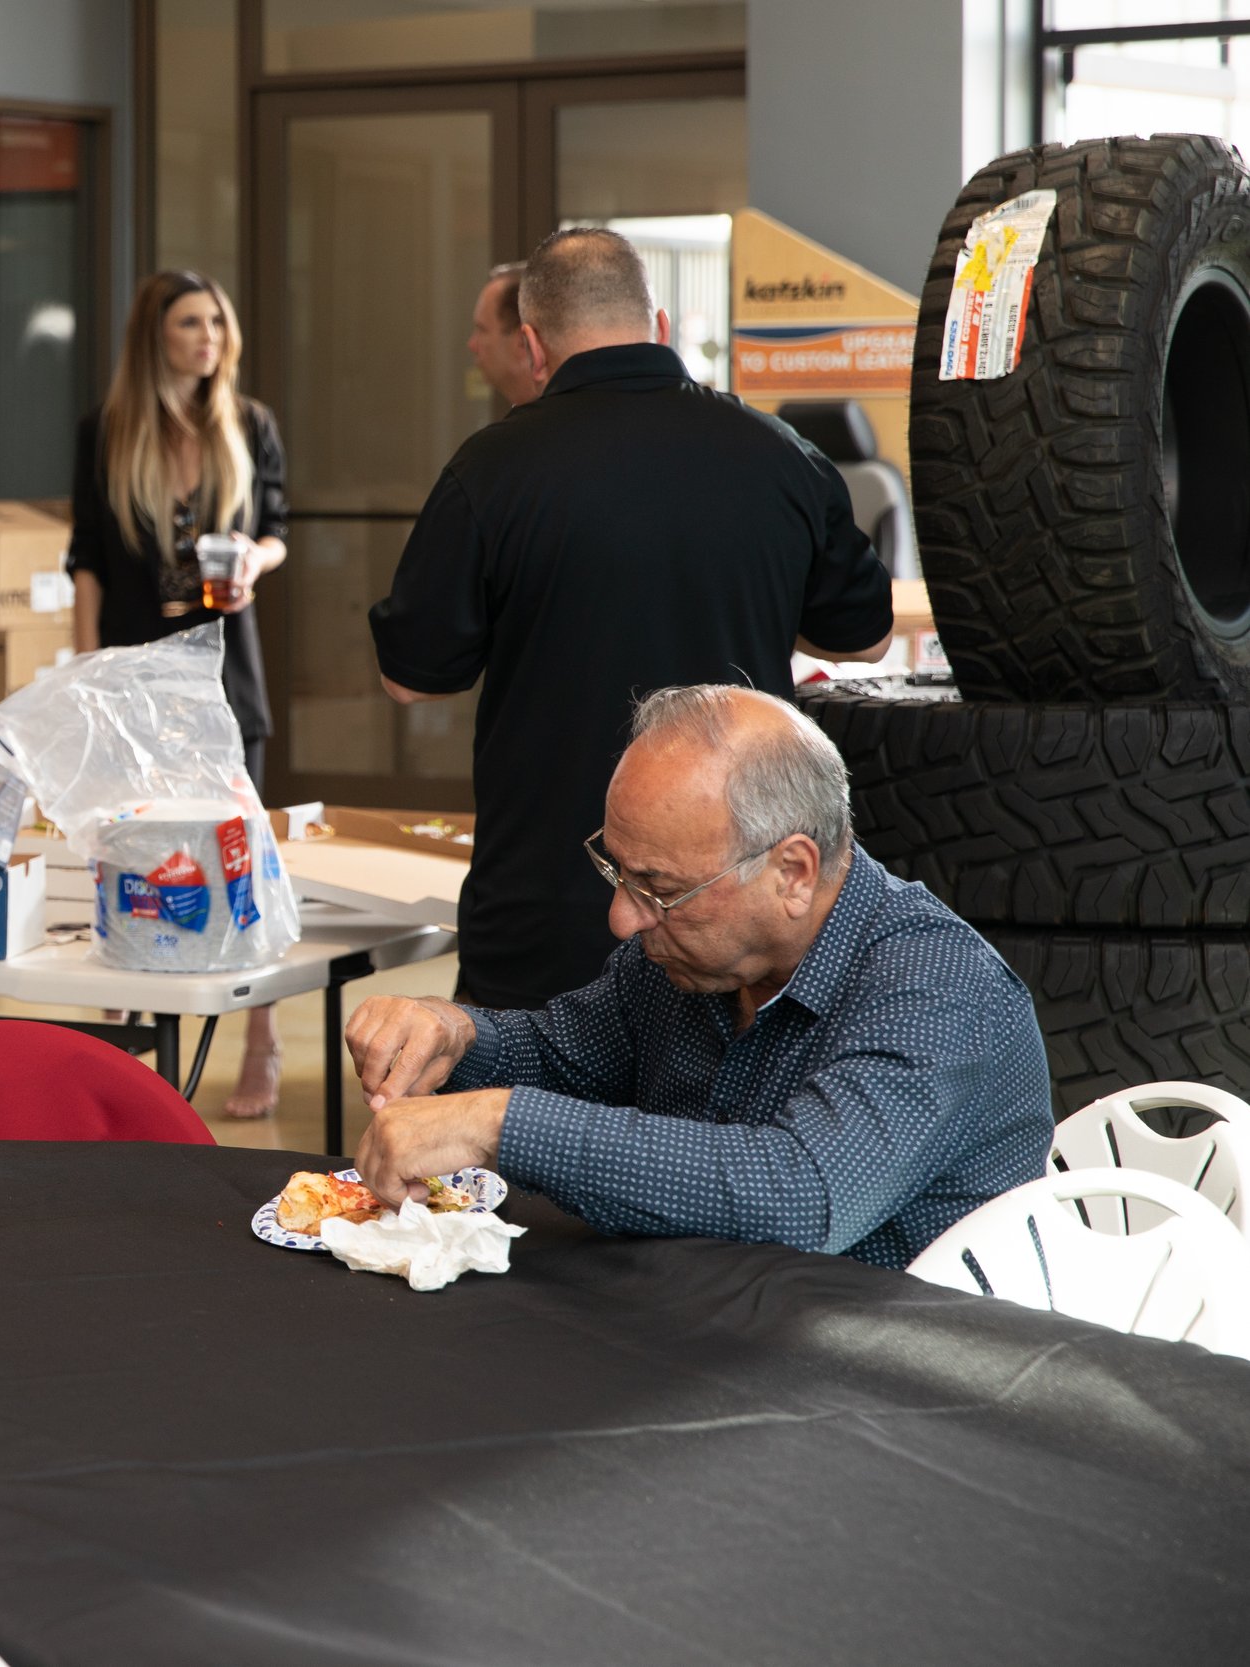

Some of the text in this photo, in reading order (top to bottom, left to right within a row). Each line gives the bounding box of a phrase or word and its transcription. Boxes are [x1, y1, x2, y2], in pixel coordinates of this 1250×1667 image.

[842, 331, 915, 353] UPGRA
[740, 350, 913, 373] TO CUSTOM LEATH
